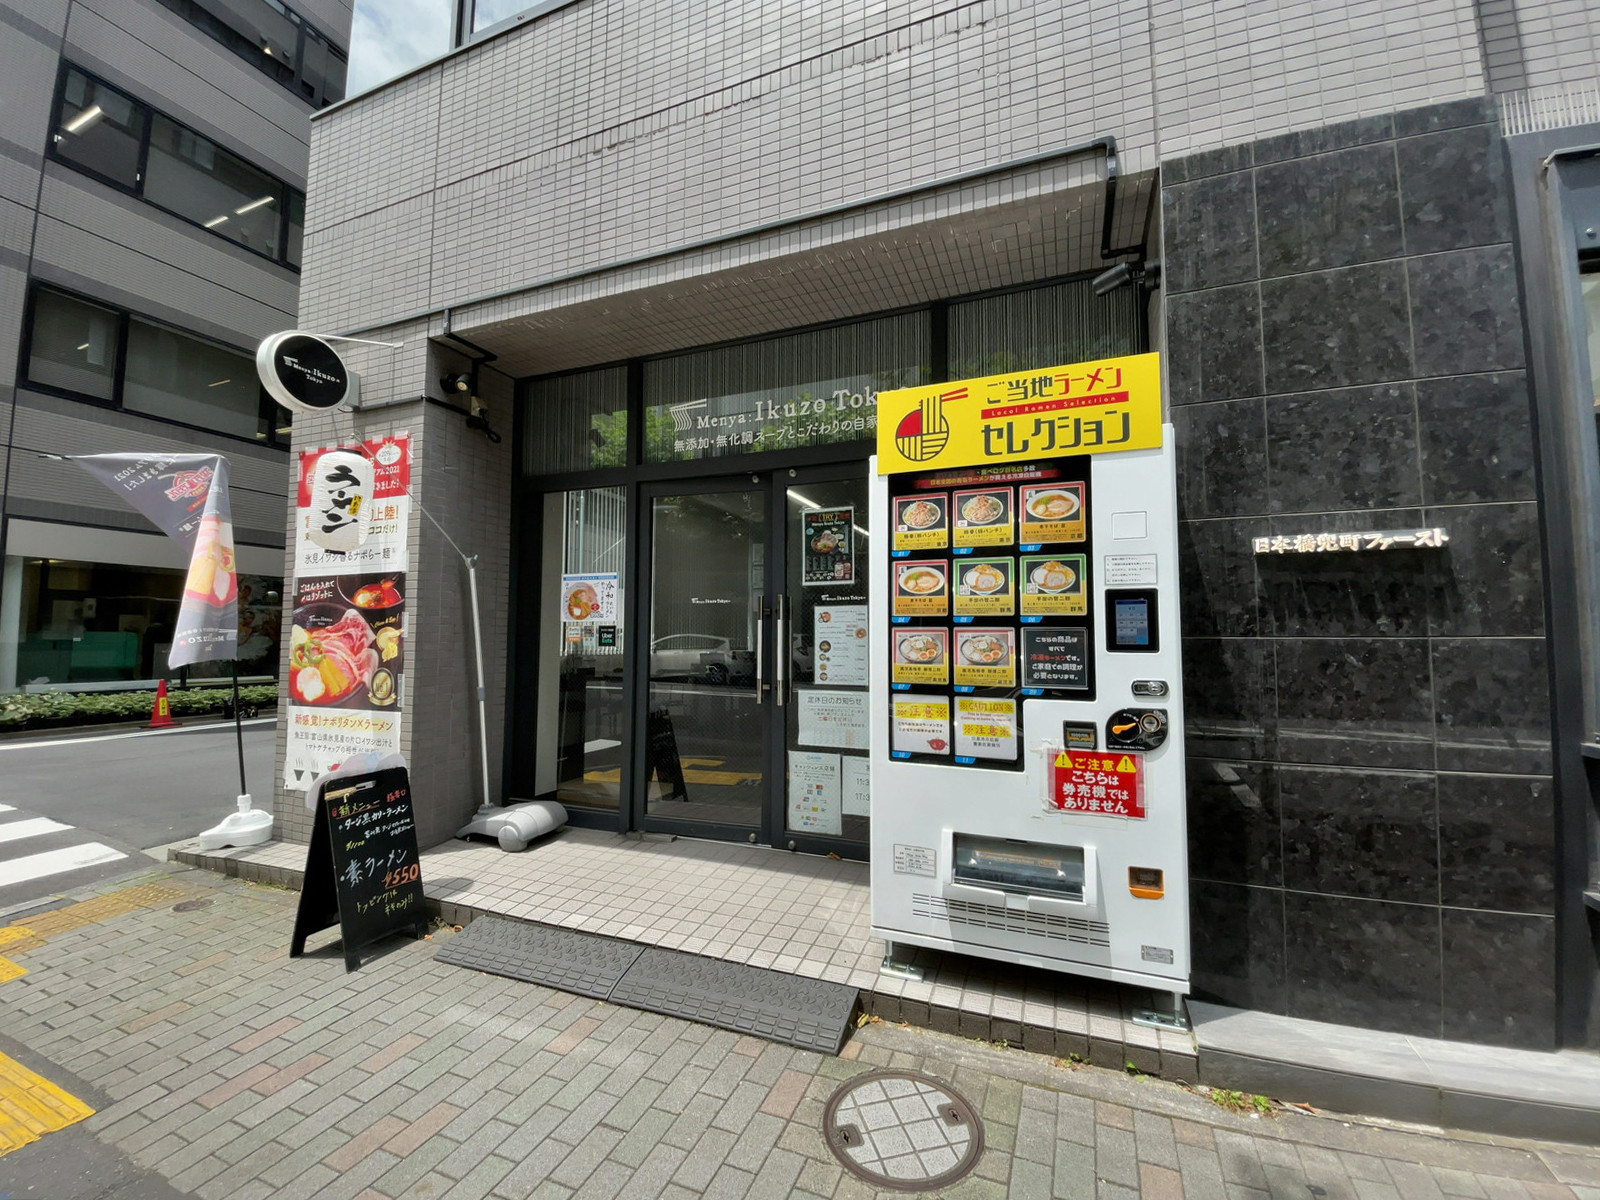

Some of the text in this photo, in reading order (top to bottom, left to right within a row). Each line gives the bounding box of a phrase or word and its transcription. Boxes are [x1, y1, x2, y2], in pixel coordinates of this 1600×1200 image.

[986, 367, 1122, 405] ご当地ラーメン
[755, 399, 826, 422] Ikuzo
[991, 395, 1116, 416] Local Ramen Selection
[981, 409, 1130, 457] セレクション
[321, 465, 361, 534] ラーメン
[1254, 528, 1449, 554] 日本橋兜町ファースト
[1035, 635, 1078, 643] こちらの商品は
[808, 696, 862, 706] 定休日のお知らせ
[295, 713, 393, 731] 新感覚!ナポリタン×ラーメン
[1074, 758, 1115, 772] ご注意
[1071, 770, 1119, 785] こちらは
[1062, 782, 1129, 800] 券売機では
[1064, 797, 1129, 814] ありません
[382, 863, 419, 888] ¥550
